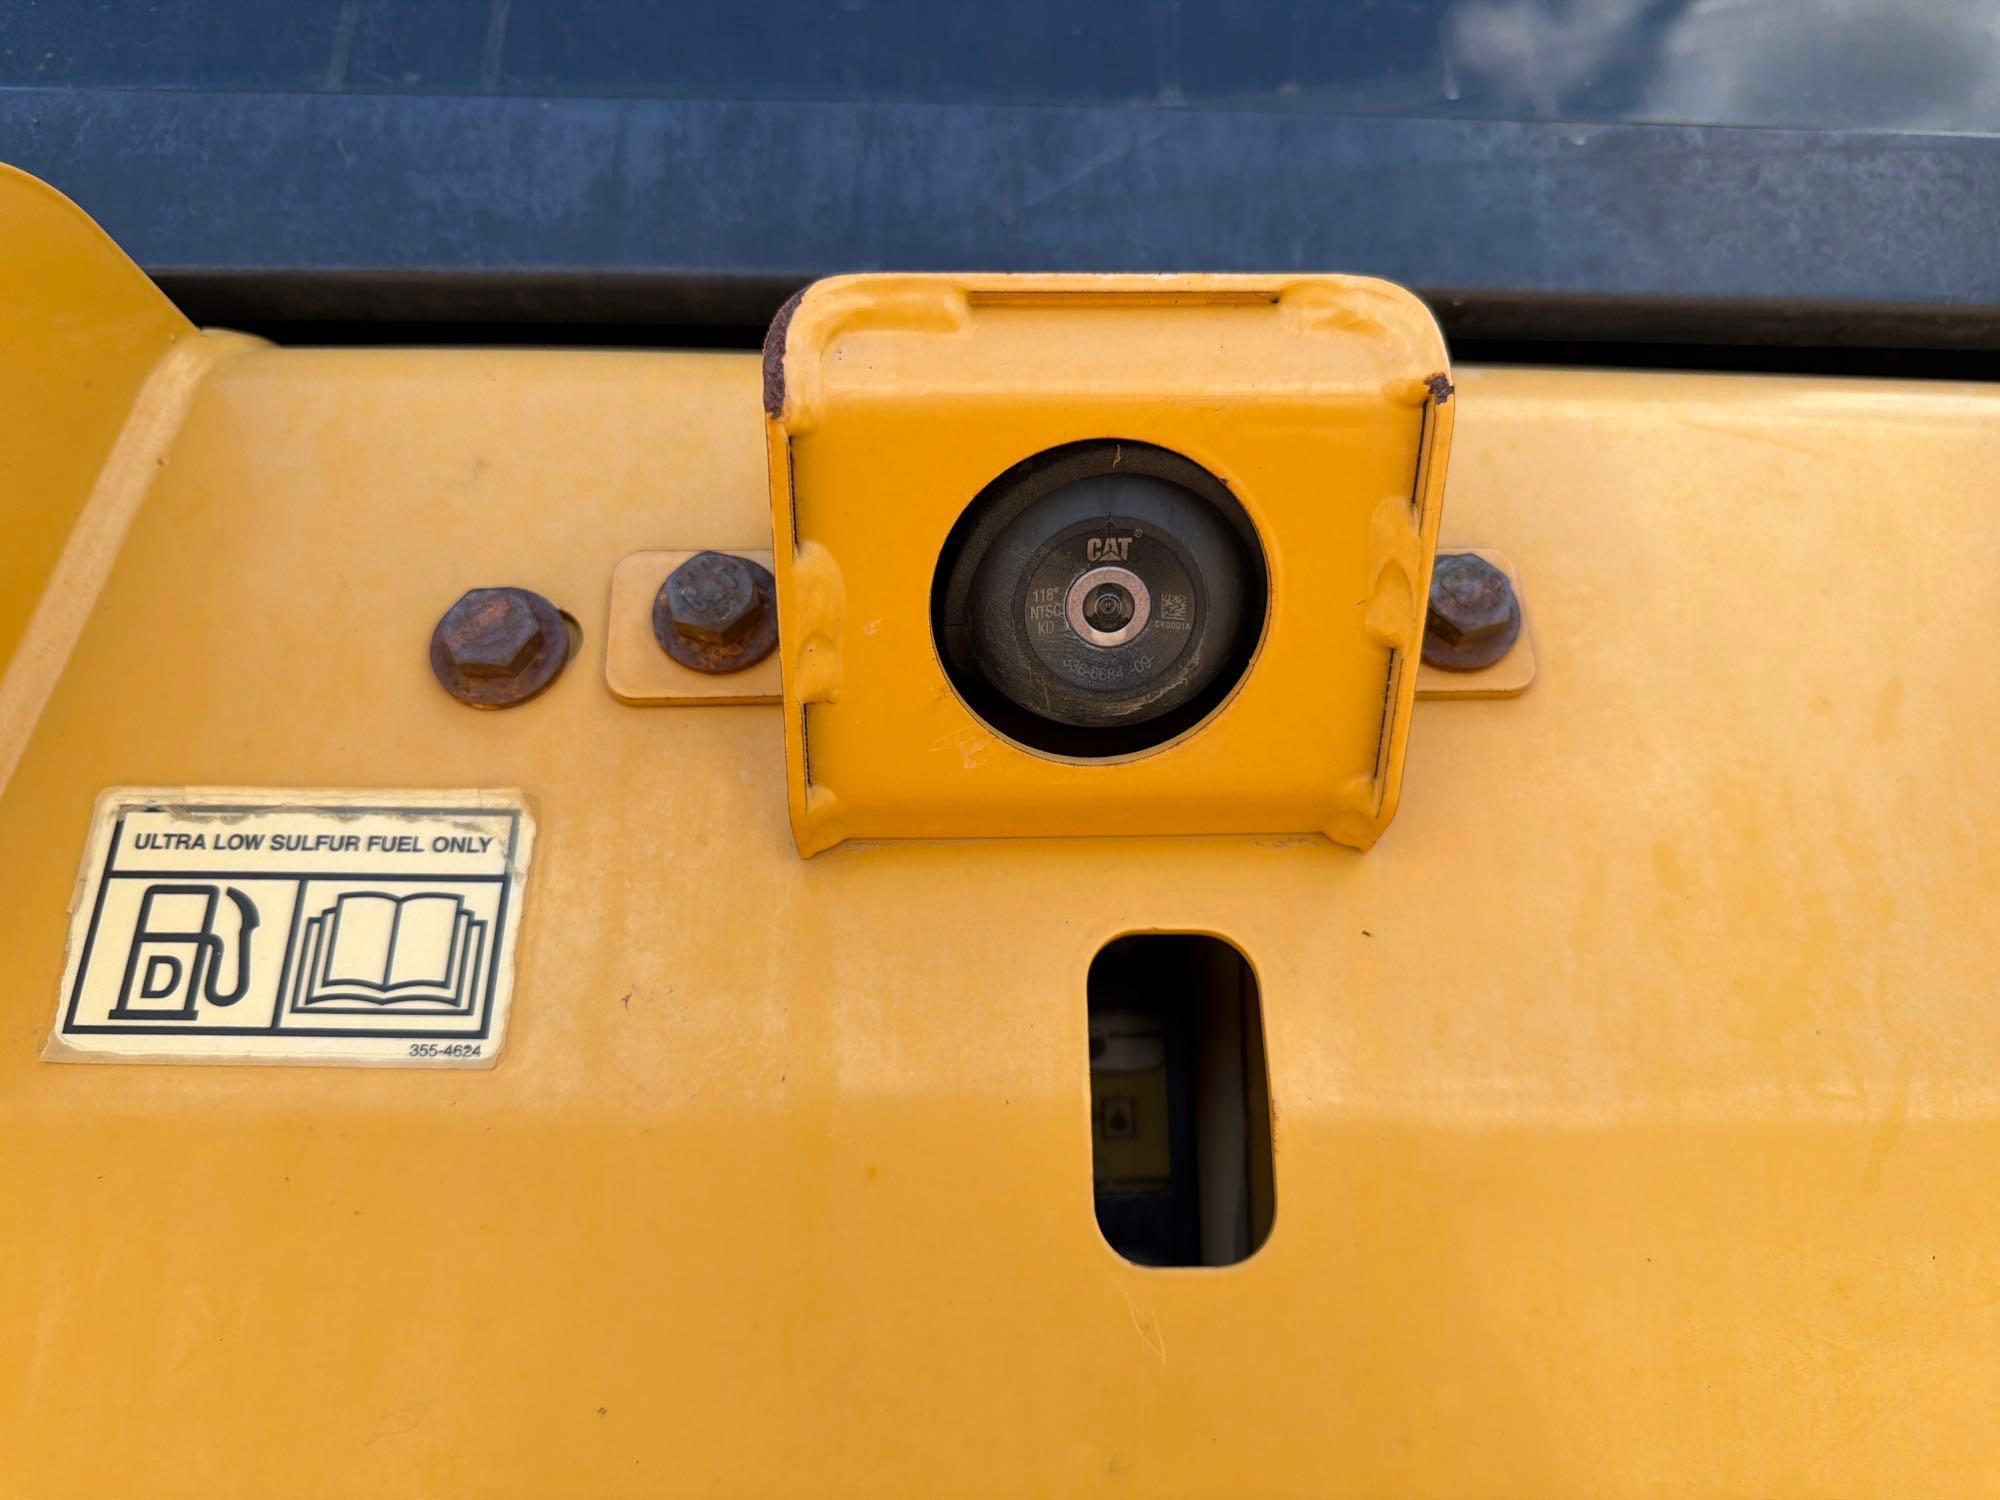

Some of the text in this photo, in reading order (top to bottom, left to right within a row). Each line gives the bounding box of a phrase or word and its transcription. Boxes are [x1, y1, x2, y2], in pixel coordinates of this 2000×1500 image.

[1030, 602, 1061, 620] NTSC
[134, 833, 496, 853] ULTRA LOW SULFUR FUEL ONLY
[409, 1043, 482, 1058] 355-4624
